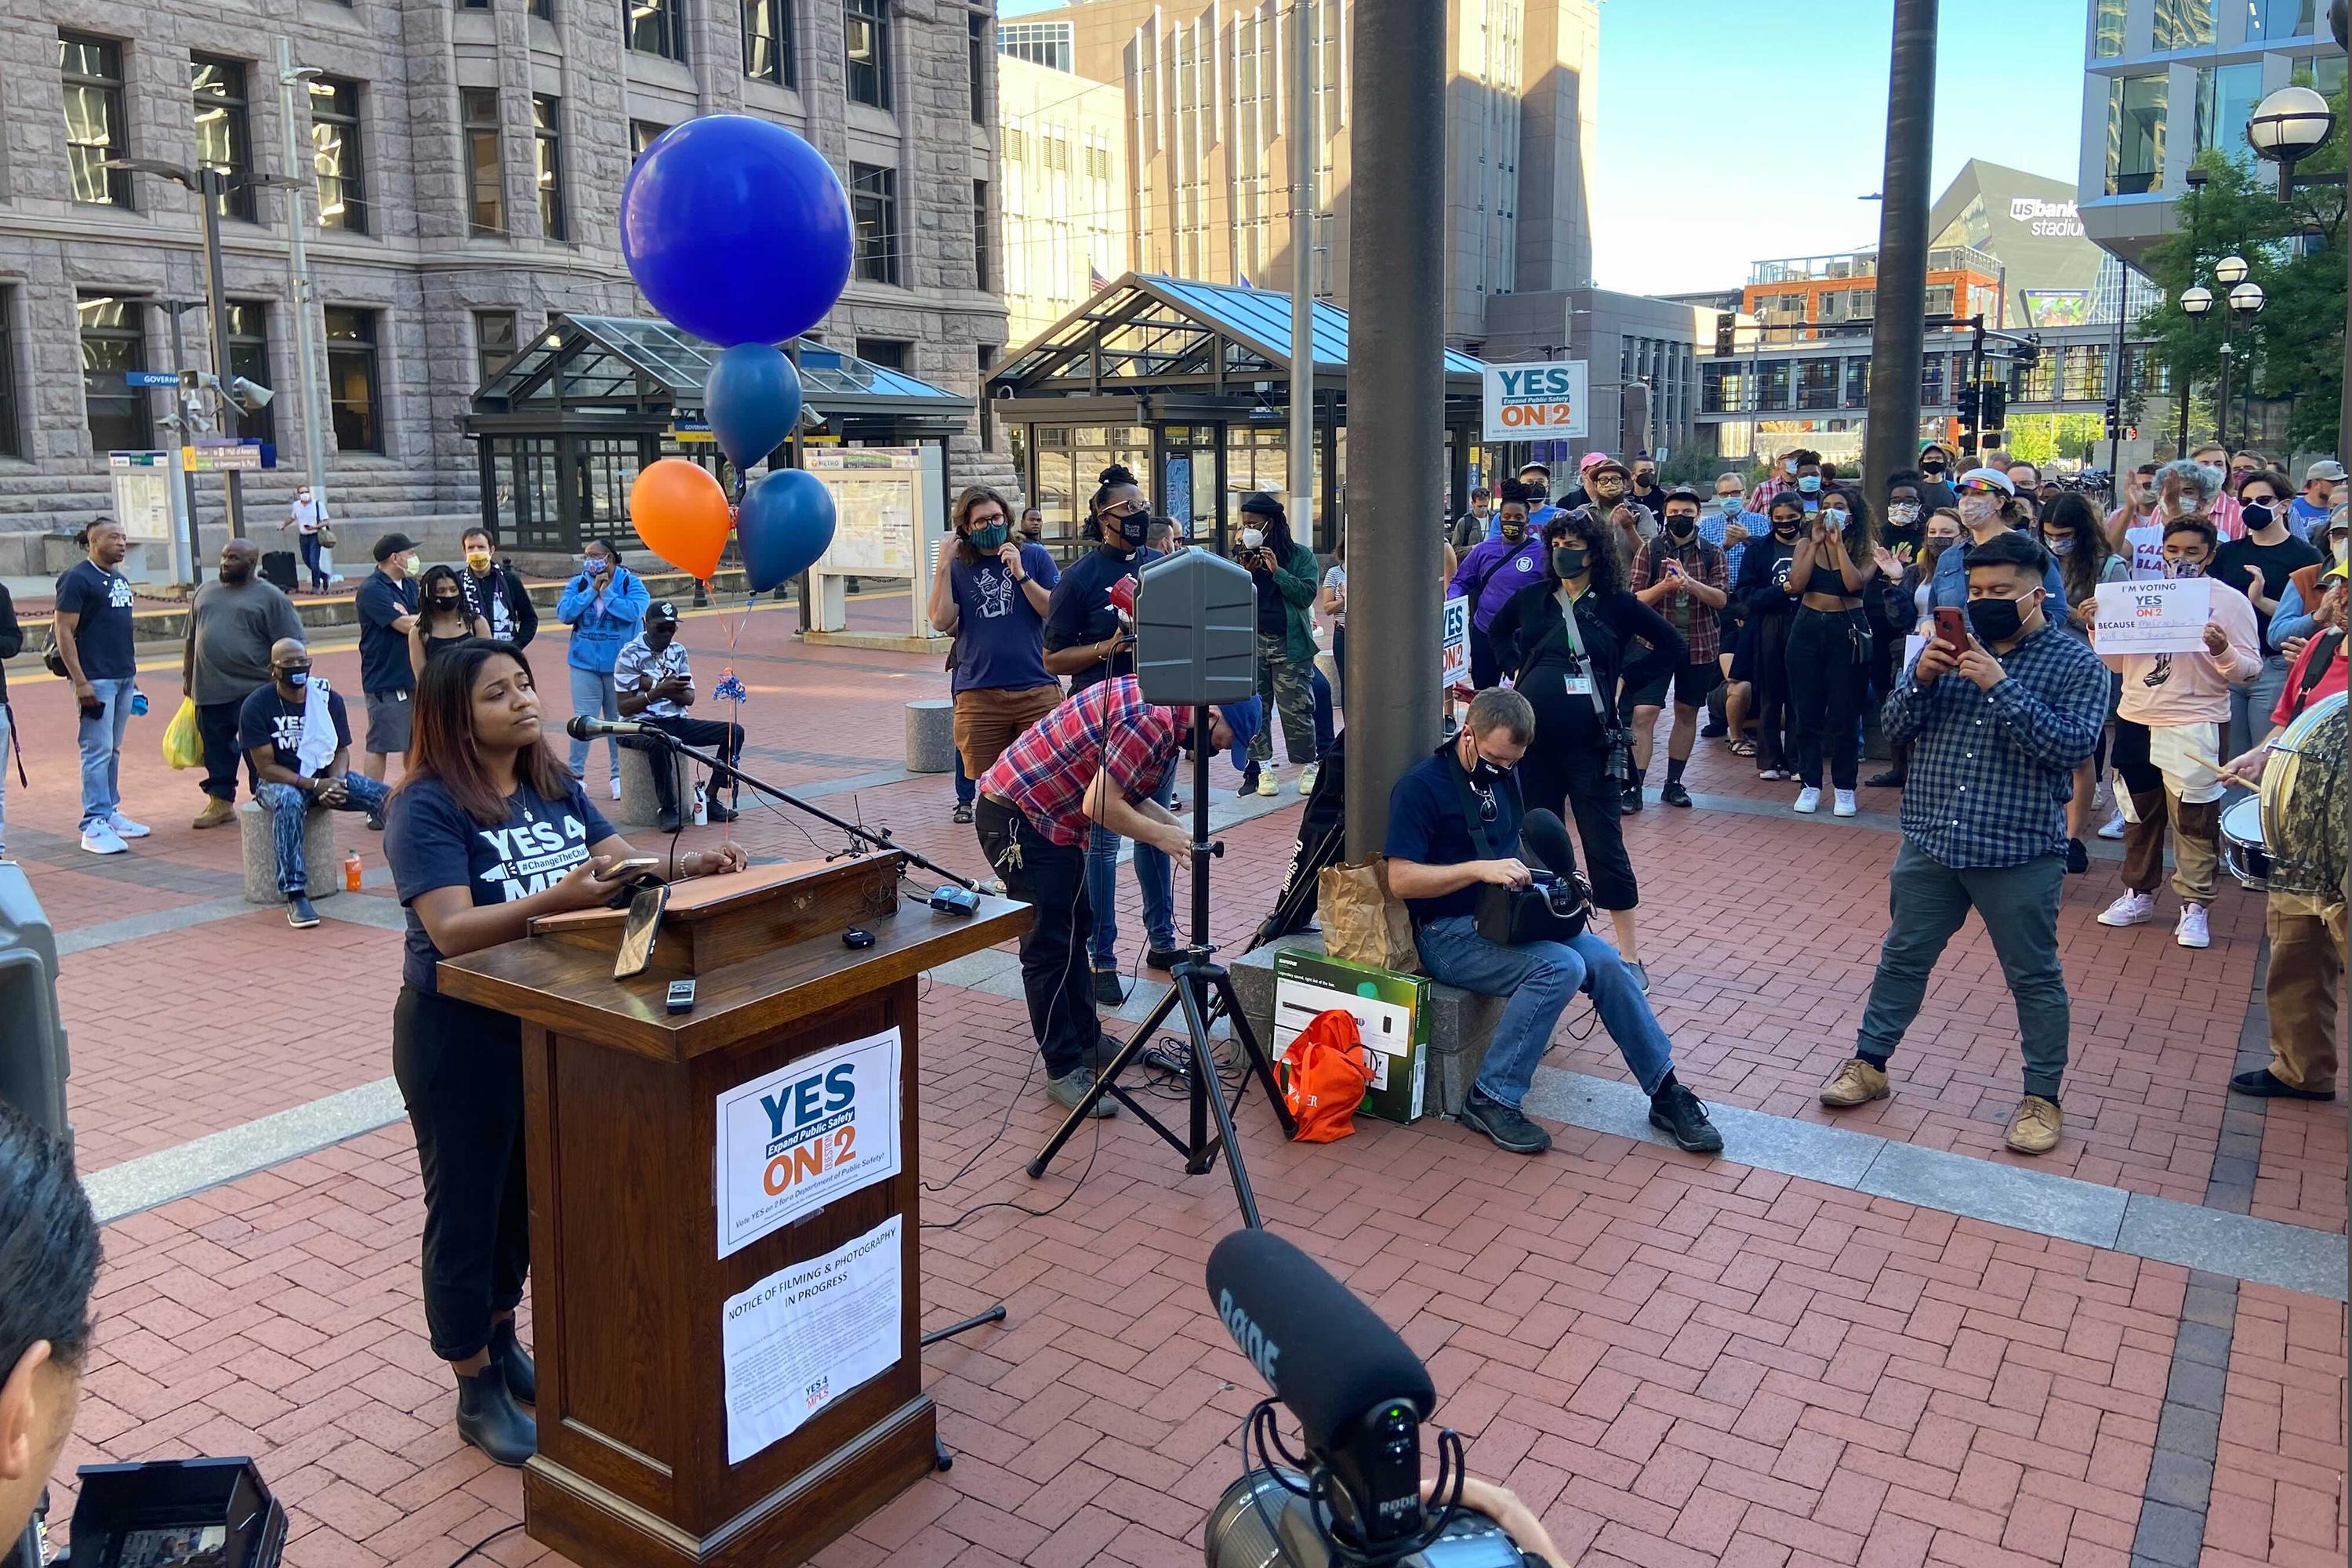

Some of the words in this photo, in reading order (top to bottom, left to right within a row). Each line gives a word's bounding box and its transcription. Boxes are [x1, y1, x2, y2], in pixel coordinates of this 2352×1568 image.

[1498, 368, 1569, 395] YES
[1503, 397, 1526, 405] Expand
[1501, 405, 1545, 426] ON
[1553, 404, 1570, 424] 2
[2136, 595, 2162, 605] YES
[2136, 608, 2153, 617] ON
[2098, 621, 2136, 630] BECAUSE
[1457, 644, 1464, 666] 2
[479, 821, 565, 861] YES
[564, 815, 586, 840] 4
[1282, 838, 1303, 893] On-Stage
[760, 1063, 855, 1139] YES
[768, 1133, 798, 1156] Expand
[800, 1124, 827, 1141] Public
[827, 1110, 854, 1130] Safety
[764, 1138, 823, 1196] ON
[824, 1133, 833, 1171] QUESTION
[834, 1125, 856, 1167] 2
[735, 1218, 750, 1229] Vote
[751, 1207, 764, 1221] YES
[764, 1204, 773, 1213] on
[779, 1196, 789, 1206] for
[794, 1174, 833, 1198] Department
[833, 1171, 841, 1180] of
[841, 1163, 861, 1177] Public
[862, 1152, 884, 1167] Safety!
[728, 1294, 763, 1322] NOTICE
[764, 1287, 777, 1301] OF
[779, 1267, 822, 1294] FILMING
[824, 1263, 832, 1274] &
[834, 1227, 896, 1269] PHOTOGRAPHY
[785, 1294, 796, 1308] IN
[798, 1271, 848, 1302] PROGRESS
[805, 1379, 821, 1396] YES
[808, 1388, 829, 1410] MPLS
[1239, 1483, 1270, 1505] Caon
